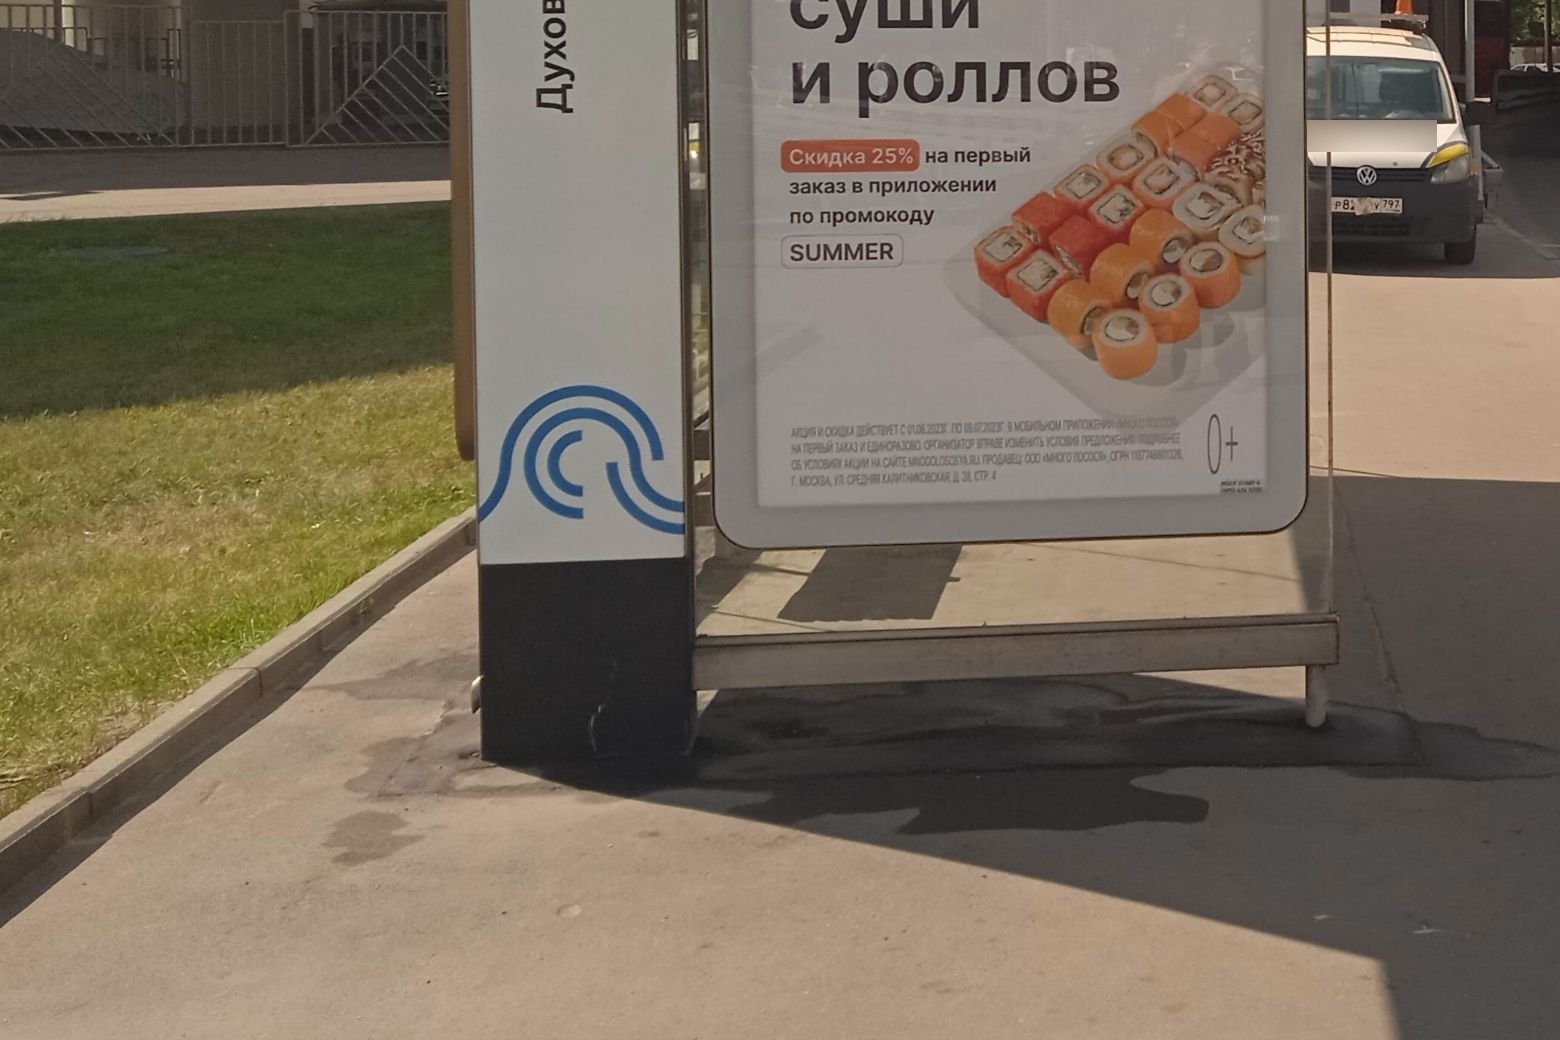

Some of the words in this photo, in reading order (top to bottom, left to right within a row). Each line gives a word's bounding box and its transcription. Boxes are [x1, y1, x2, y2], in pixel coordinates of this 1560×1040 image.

[792, 61, 831, 104] и
[858, 60, 1121, 118] роллов
[789, 149, 865, 167] Скидка
[872, 147, 914, 164] 25%
[925, 150, 948, 163] на
[954, 147, 1031, 167] первый
[789, 180, 846, 194] заказ
[852, 180, 863, 193] в
[869, 178, 996, 197] приложении
[789, 210, 814, 224] по
[820, 209, 935, 227] промокоду
[790, 242, 894, 262] SUMMER
[1207, 413, 1239, 474] 0+
